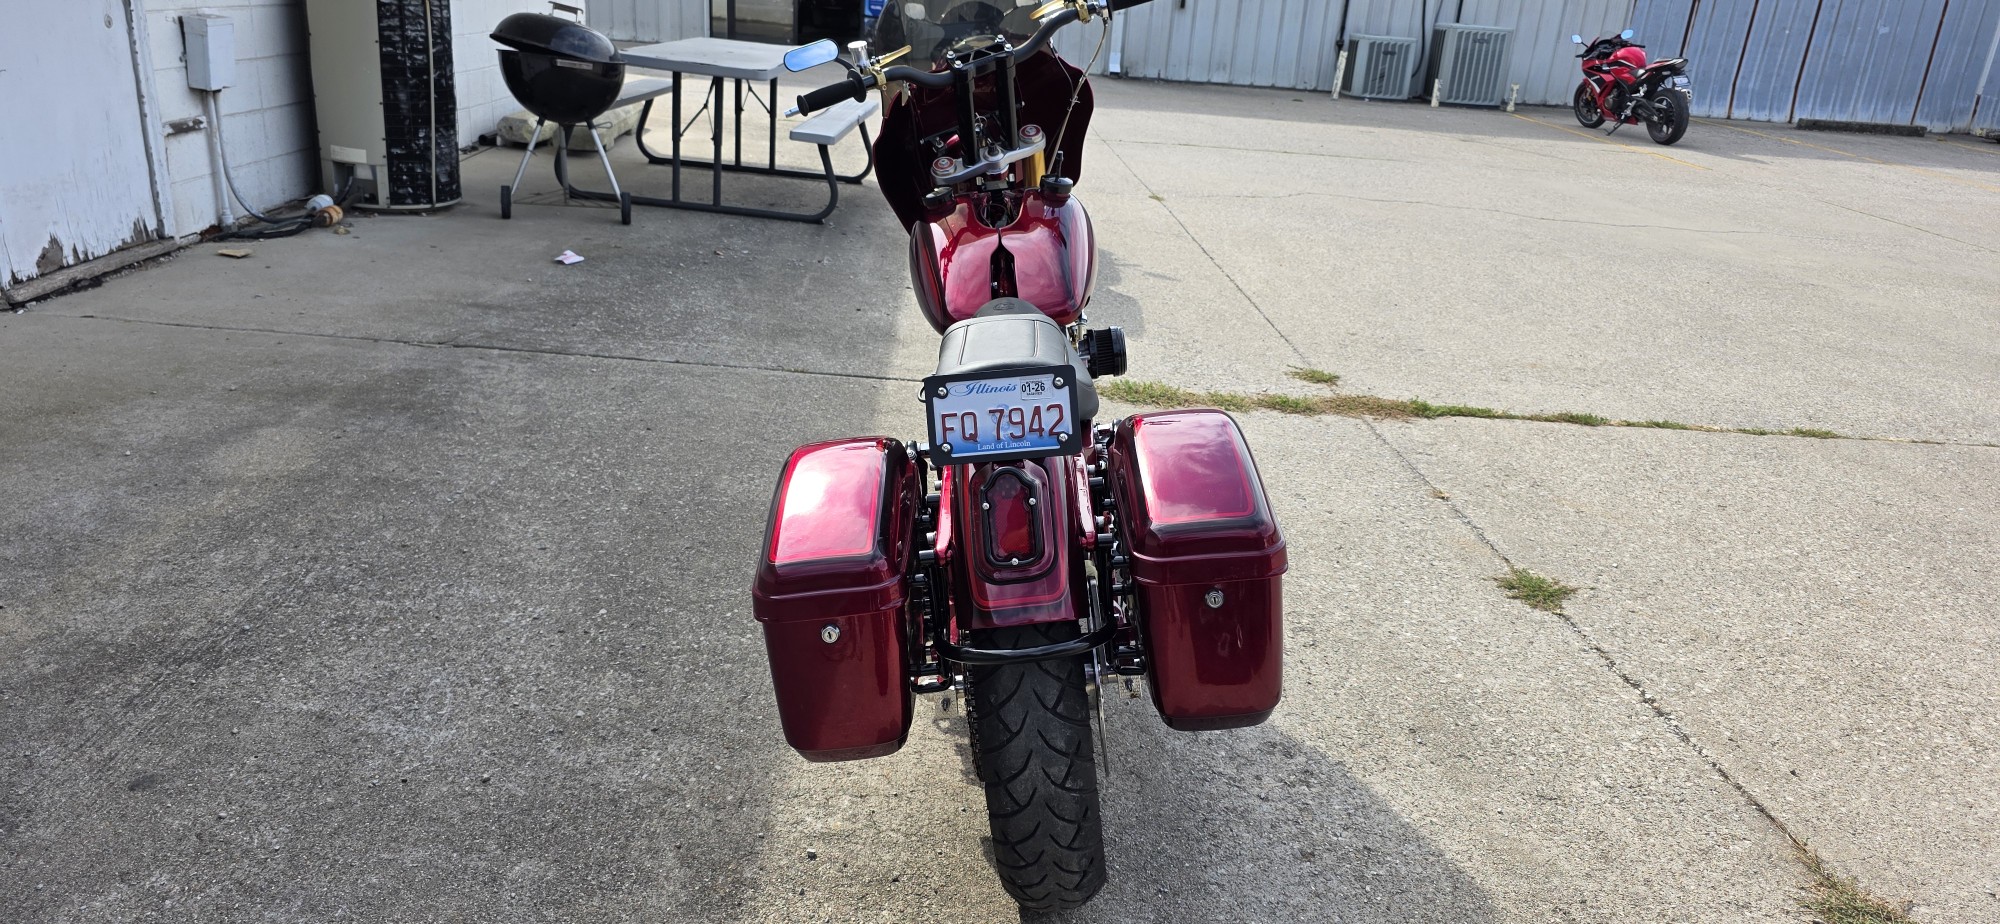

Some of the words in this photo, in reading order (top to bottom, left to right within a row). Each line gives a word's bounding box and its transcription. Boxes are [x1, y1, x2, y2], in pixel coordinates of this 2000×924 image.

[948, 380, 1018, 397] Illinois
[1021, 382, 1046, 393] 01-26
[941, 411, 979, 443] FQ
[988, 403, 1065, 441] 7942
[977, 443, 995, 451] Land
[996, 442, 1004, 450] of
[1005, 440, 1032, 449] Lincoln
